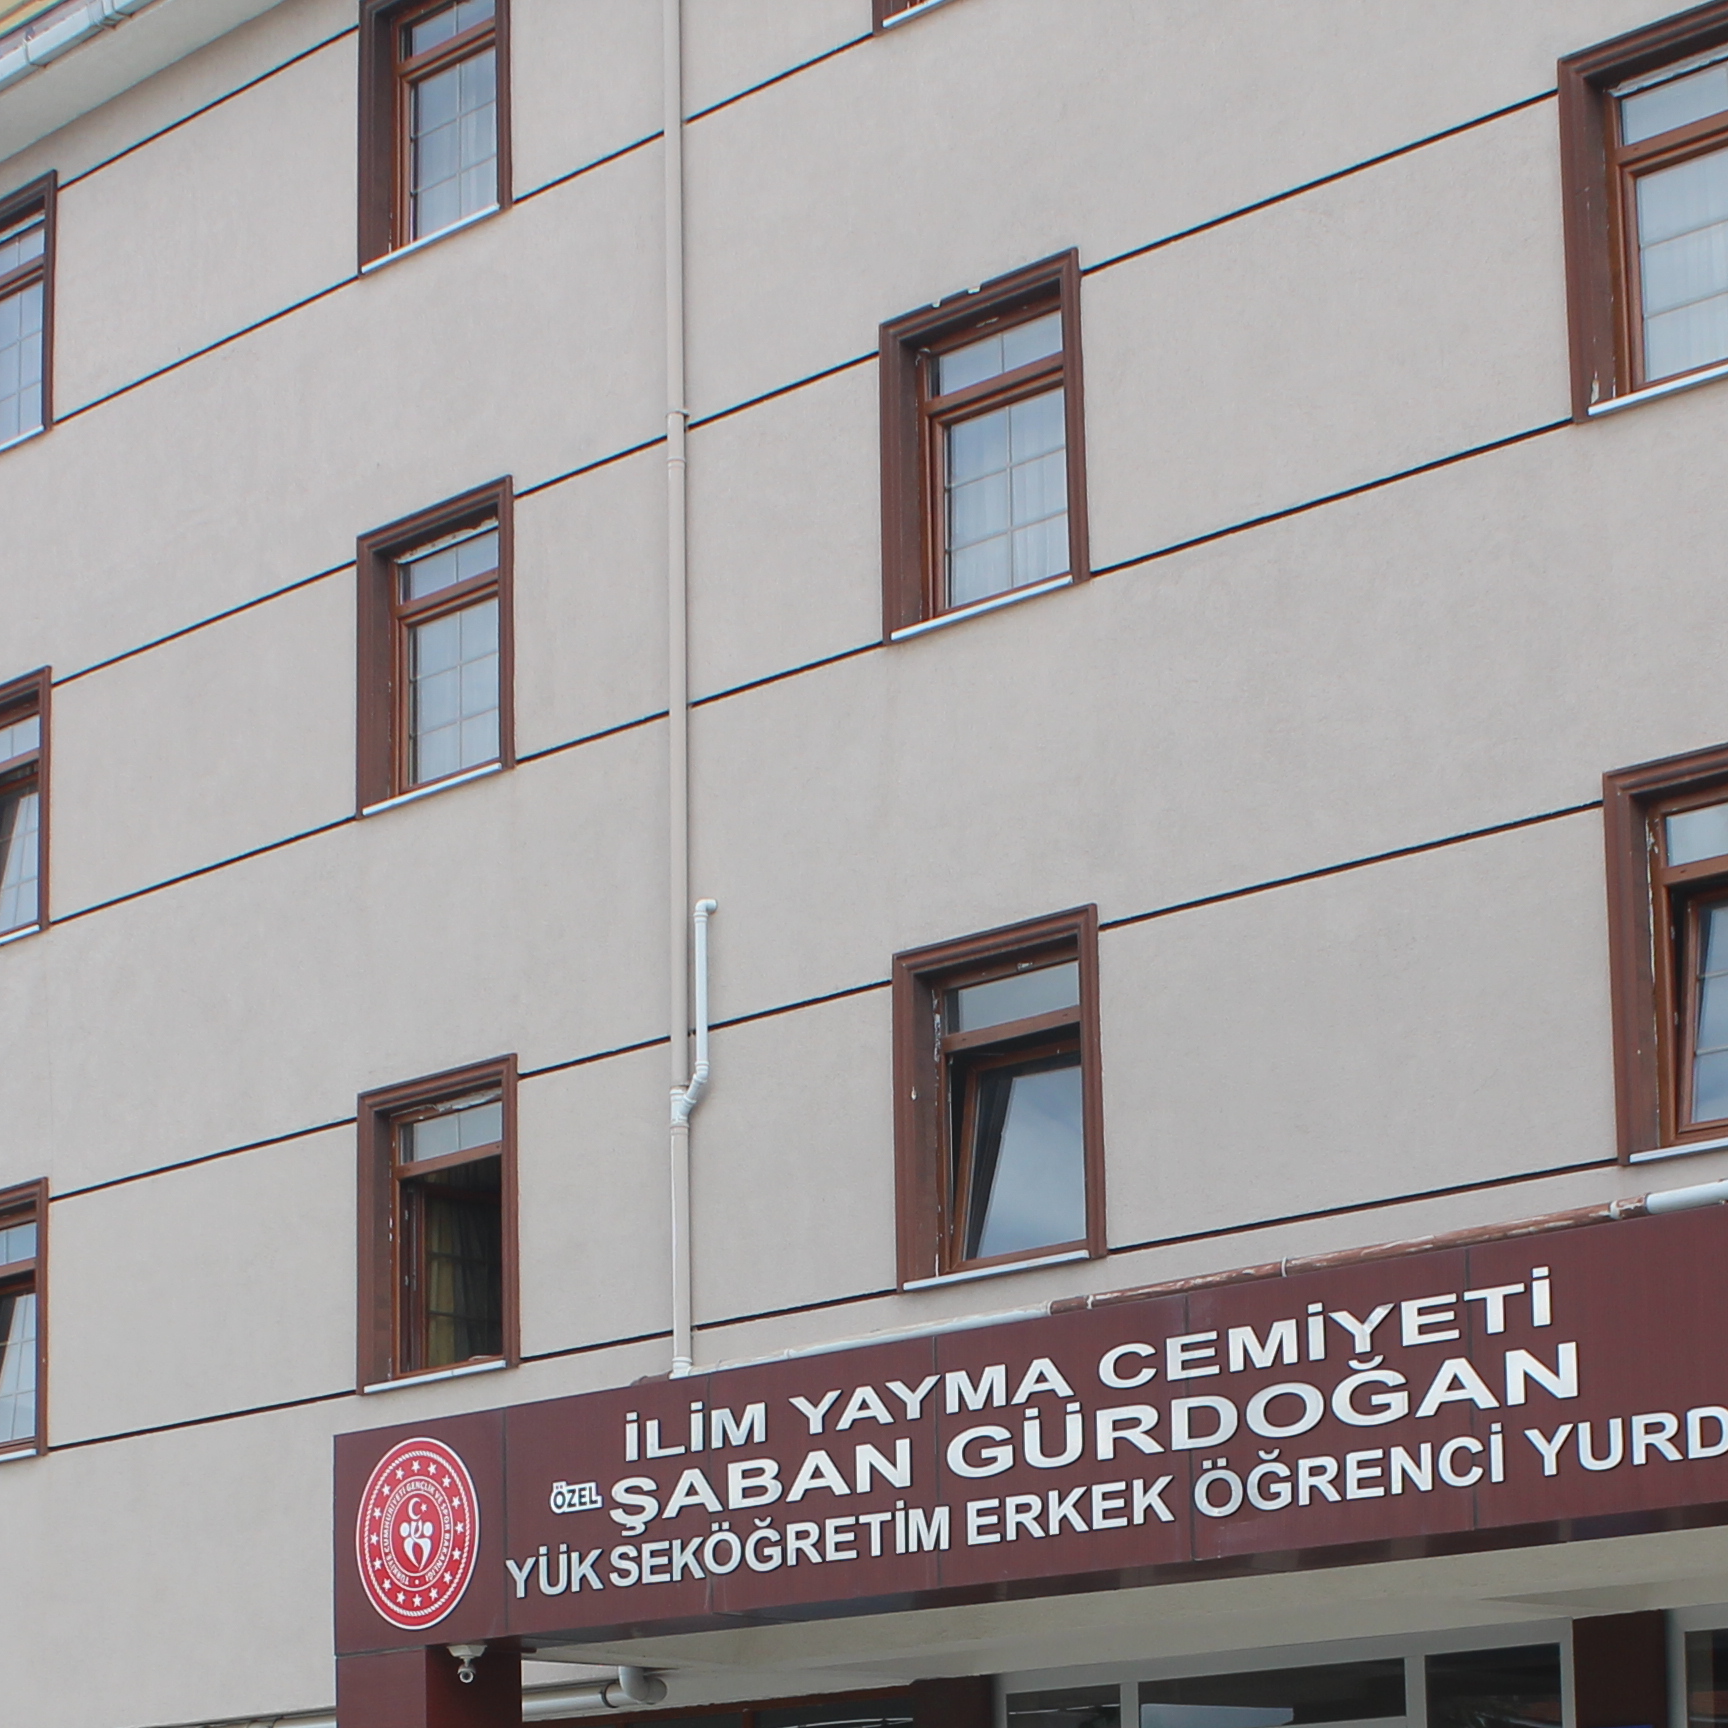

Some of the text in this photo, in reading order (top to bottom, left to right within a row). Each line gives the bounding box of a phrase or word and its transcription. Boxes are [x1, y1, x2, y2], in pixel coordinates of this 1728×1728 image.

[625, 1266, 1551, 1462] İLİM YAYMA CEMİYETİ
[550, 1481, 602, 1515] ÖZEL
[610, 1341, 1578, 1537] ŞABAN GÜRDOĞAN
[967, 1474, 1175, 1546] ERKEK
[1193, 1421, 1504, 1519] ÖĞRENCİ
[441, 1502, 451, 1531] SPOR
